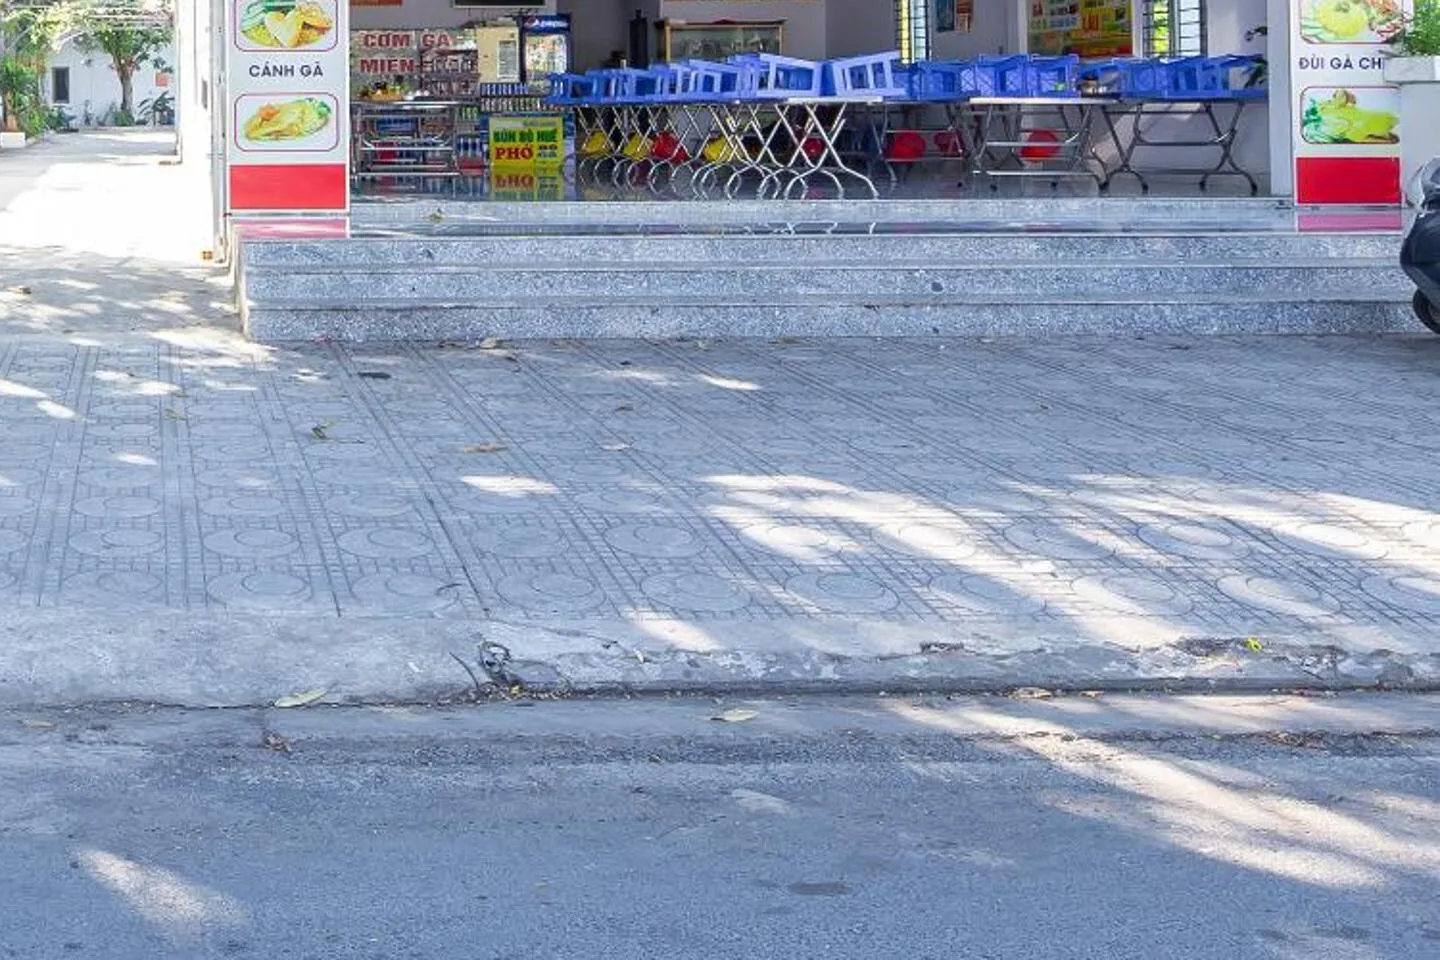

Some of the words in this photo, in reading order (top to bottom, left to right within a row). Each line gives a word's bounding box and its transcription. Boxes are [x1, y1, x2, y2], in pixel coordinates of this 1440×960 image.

[248, 62, 295, 78] CÁNH
[300, 62, 324, 77] GÀ
[1330, 54, 1354, 70] GÀ
